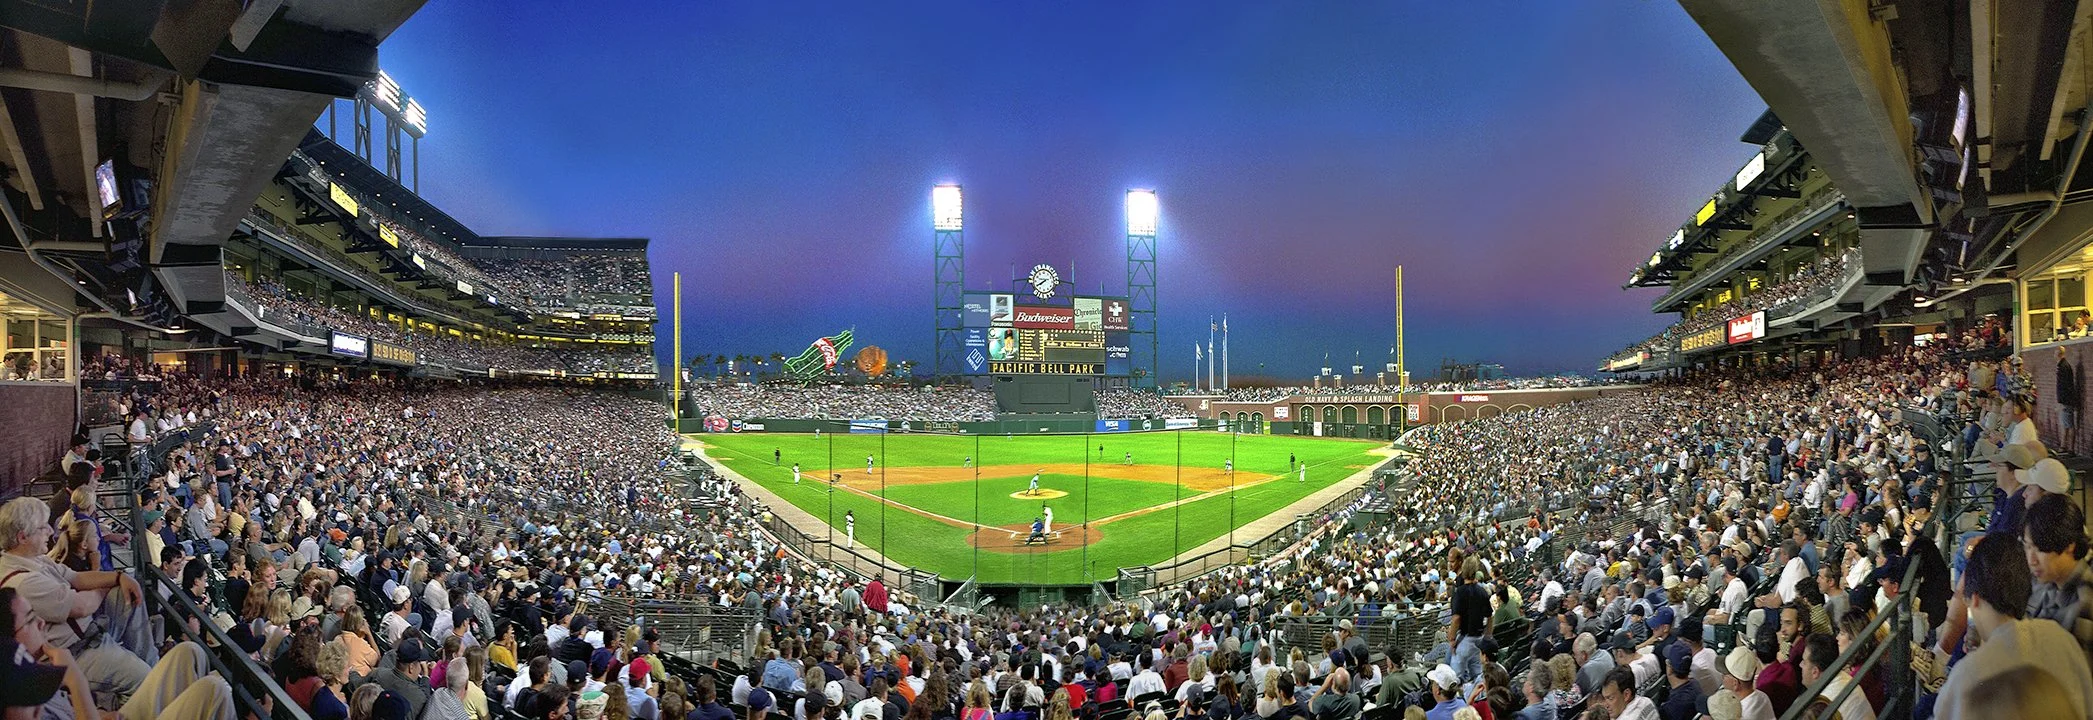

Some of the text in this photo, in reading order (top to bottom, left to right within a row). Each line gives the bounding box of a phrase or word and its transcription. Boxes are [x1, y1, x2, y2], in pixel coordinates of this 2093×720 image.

[1033, 264, 1059, 284] FRANCISCO
[1033, 289, 1055, 299] GIANTS
[1014, 311, 1073, 324] Budweiser
[1106, 345, 1129, 353] schwab
[993, 363, 1094, 374] PACIFIC BELL PARK
